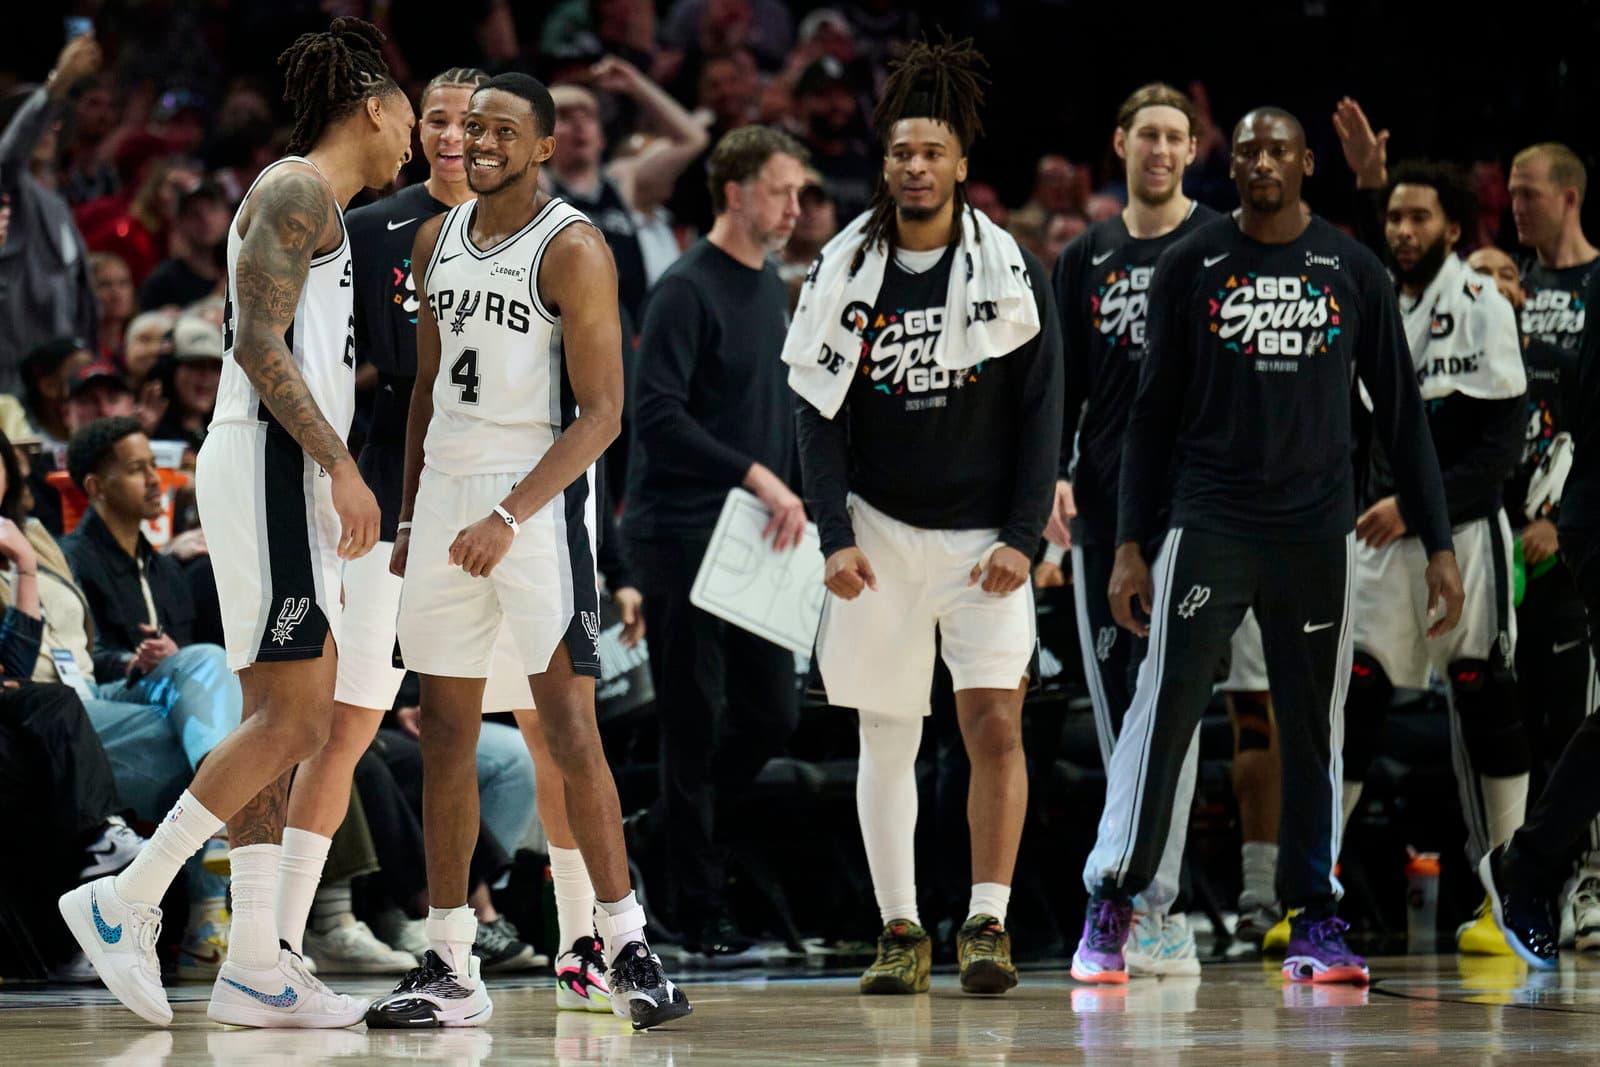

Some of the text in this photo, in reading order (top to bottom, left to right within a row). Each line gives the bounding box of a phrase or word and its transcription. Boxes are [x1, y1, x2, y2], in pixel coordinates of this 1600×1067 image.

[495, 264, 521, 278] LEDGER
[1255, 276, 1302, 301] GO
[1218, 285, 1329, 344] Spurs
[870, 323, 941, 384] Spu
[1257, 330, 1303, 356] GO
[450, 347, 481, 405] 4
[906, 367, 951, 393] GO
